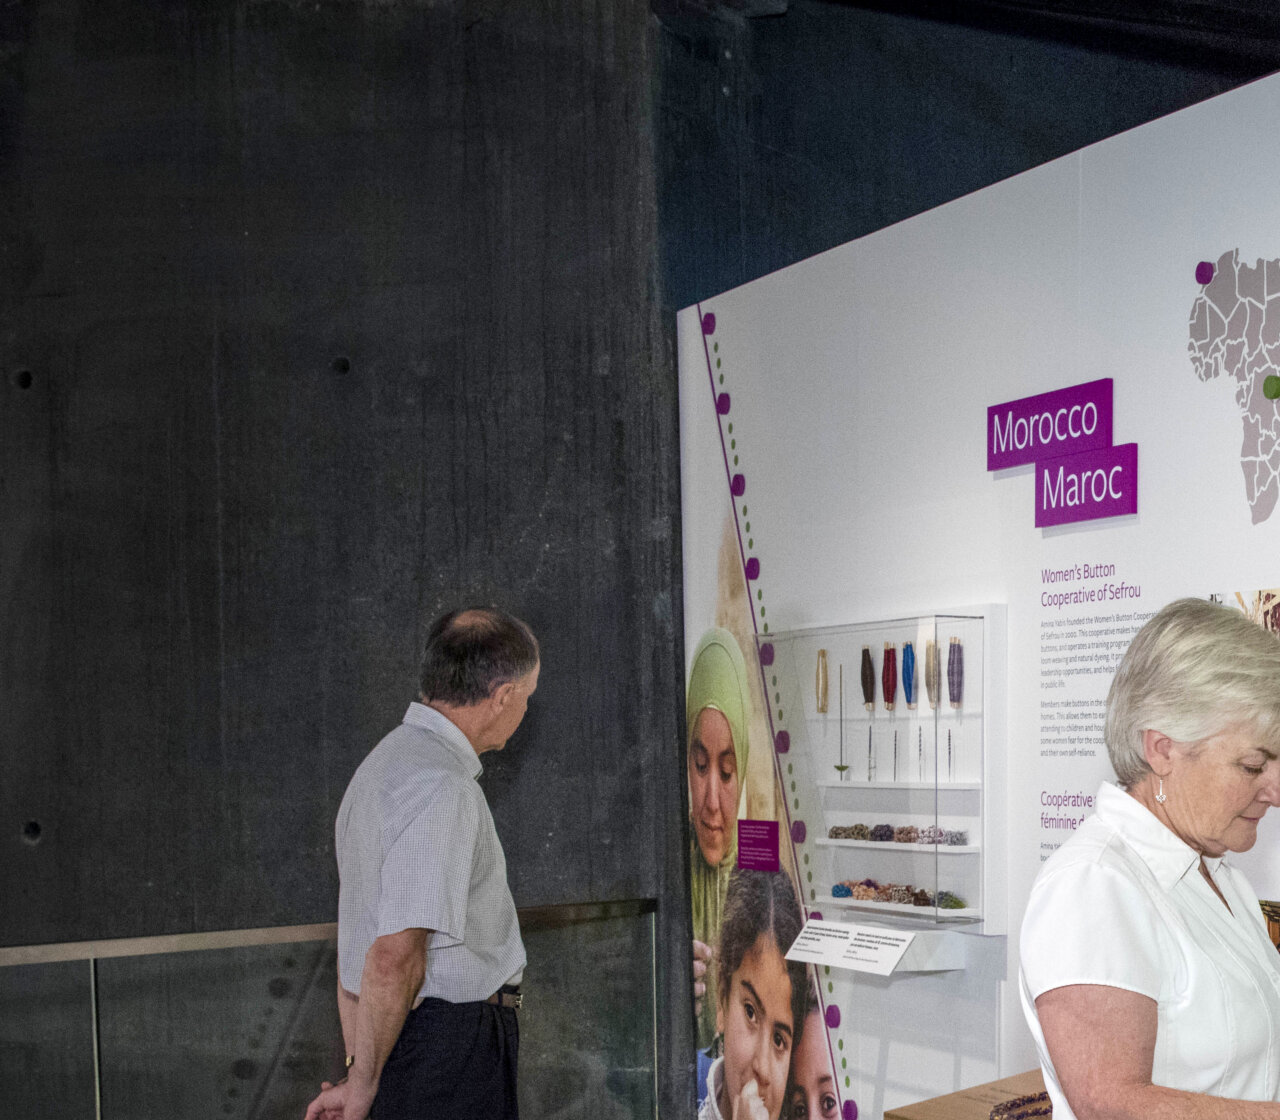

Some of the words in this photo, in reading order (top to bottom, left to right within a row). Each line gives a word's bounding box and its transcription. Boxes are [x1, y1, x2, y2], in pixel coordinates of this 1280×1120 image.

[993, 402, 1097, 454] Morocco
[1043, 465, 1122, 510] Maroc
[1083, 564, 1115, 579] Button
[1041, 586, 1096, 610] Cooperative
[1097, 583, 1108, 601] of
[1108, 581, 1141, 600] Sefrou
[1040, 790, 1094, 812] Coopérative
[1040, 812, 1077, 830] féminine
